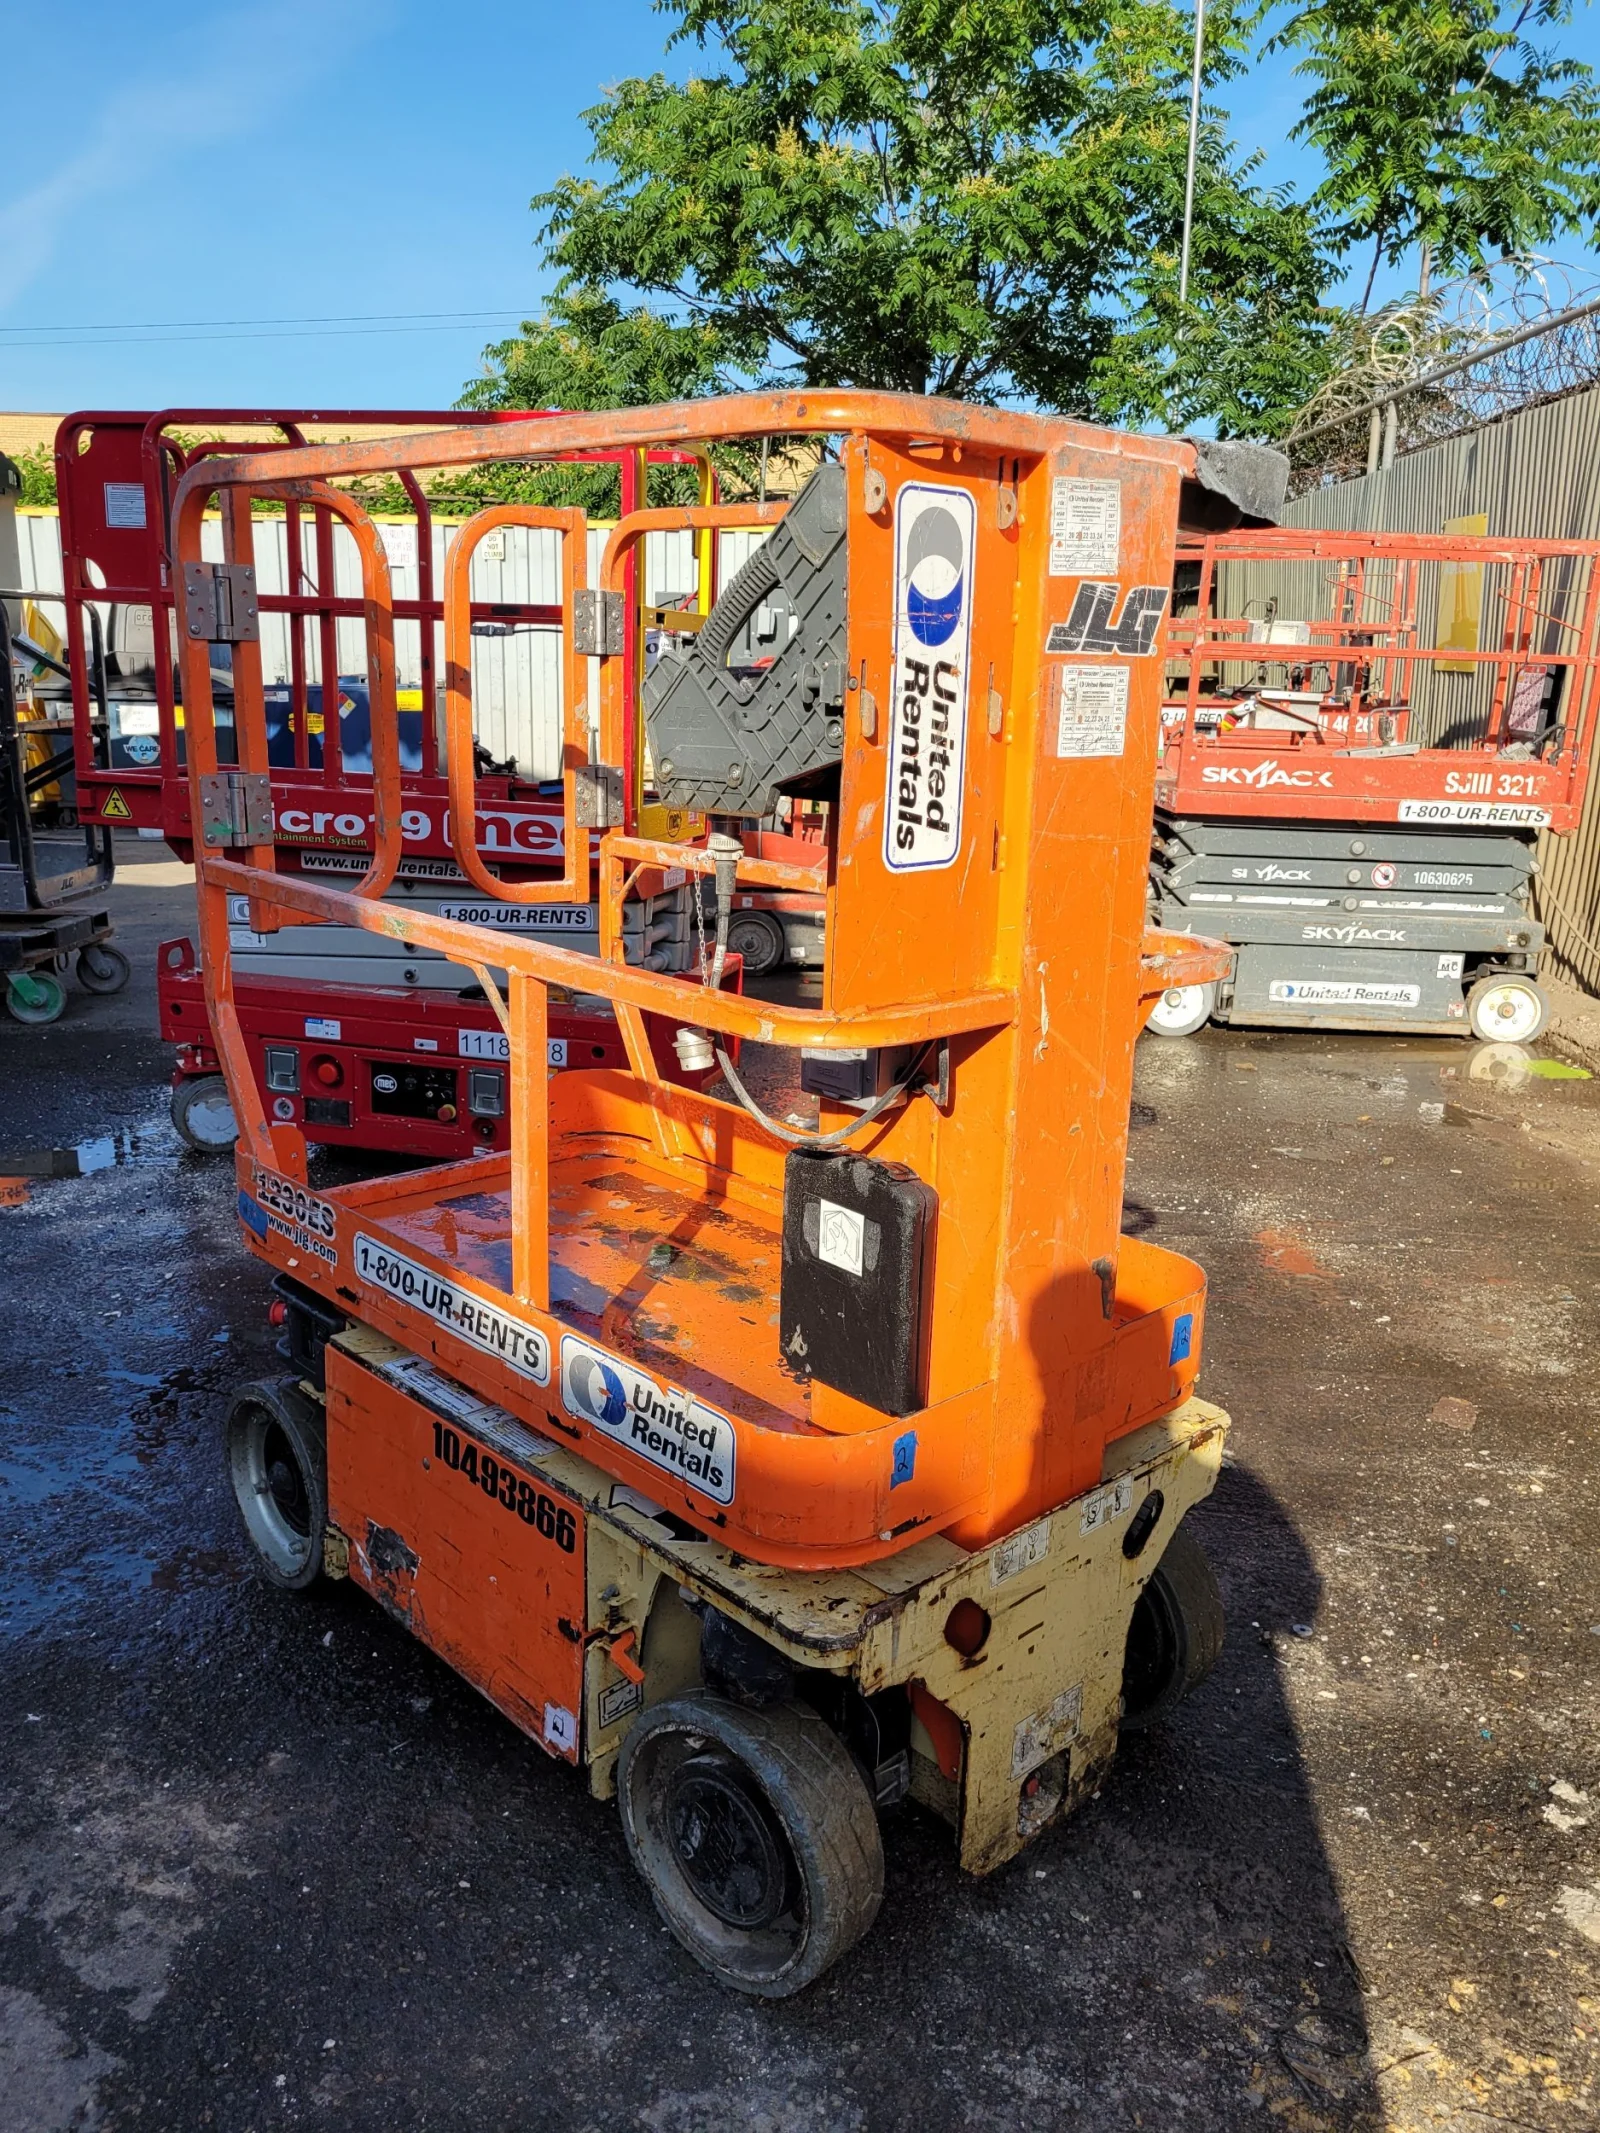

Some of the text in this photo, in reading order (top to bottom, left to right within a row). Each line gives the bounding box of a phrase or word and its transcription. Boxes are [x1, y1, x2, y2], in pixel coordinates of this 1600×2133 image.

[1045, 580, 1170, 656] JLG
[896, 656, 930, 851] Rentals
[926, 659, 957, 833] United
[1202, 759, 1334, 788] SKYJACK
[271, 802, 432, 841] icro9
[1404, 805, 1545, 823] 1-800-UR-RENTS
[273, 831, 367, 847] ntainment System
[444, 907, 587, 925] 1-800-UR-RENTS
[1302, 920, 1406, 944] SKYJACK
[1298, 986, 1411, 1001] United Rentals
[461, 1034, 563, 1062] 11188
[377, 1078, 394, 1090] mec
[267, 1213, 337, 1264] www.jlg.com
[360, 1246, 541, 1370] 1-800-UR-RENTS
[632, 1383, 718, 1453] United
[630, 1413, 724, 1488] Rentals
[432, 1421, 577, 1554] 10493866
